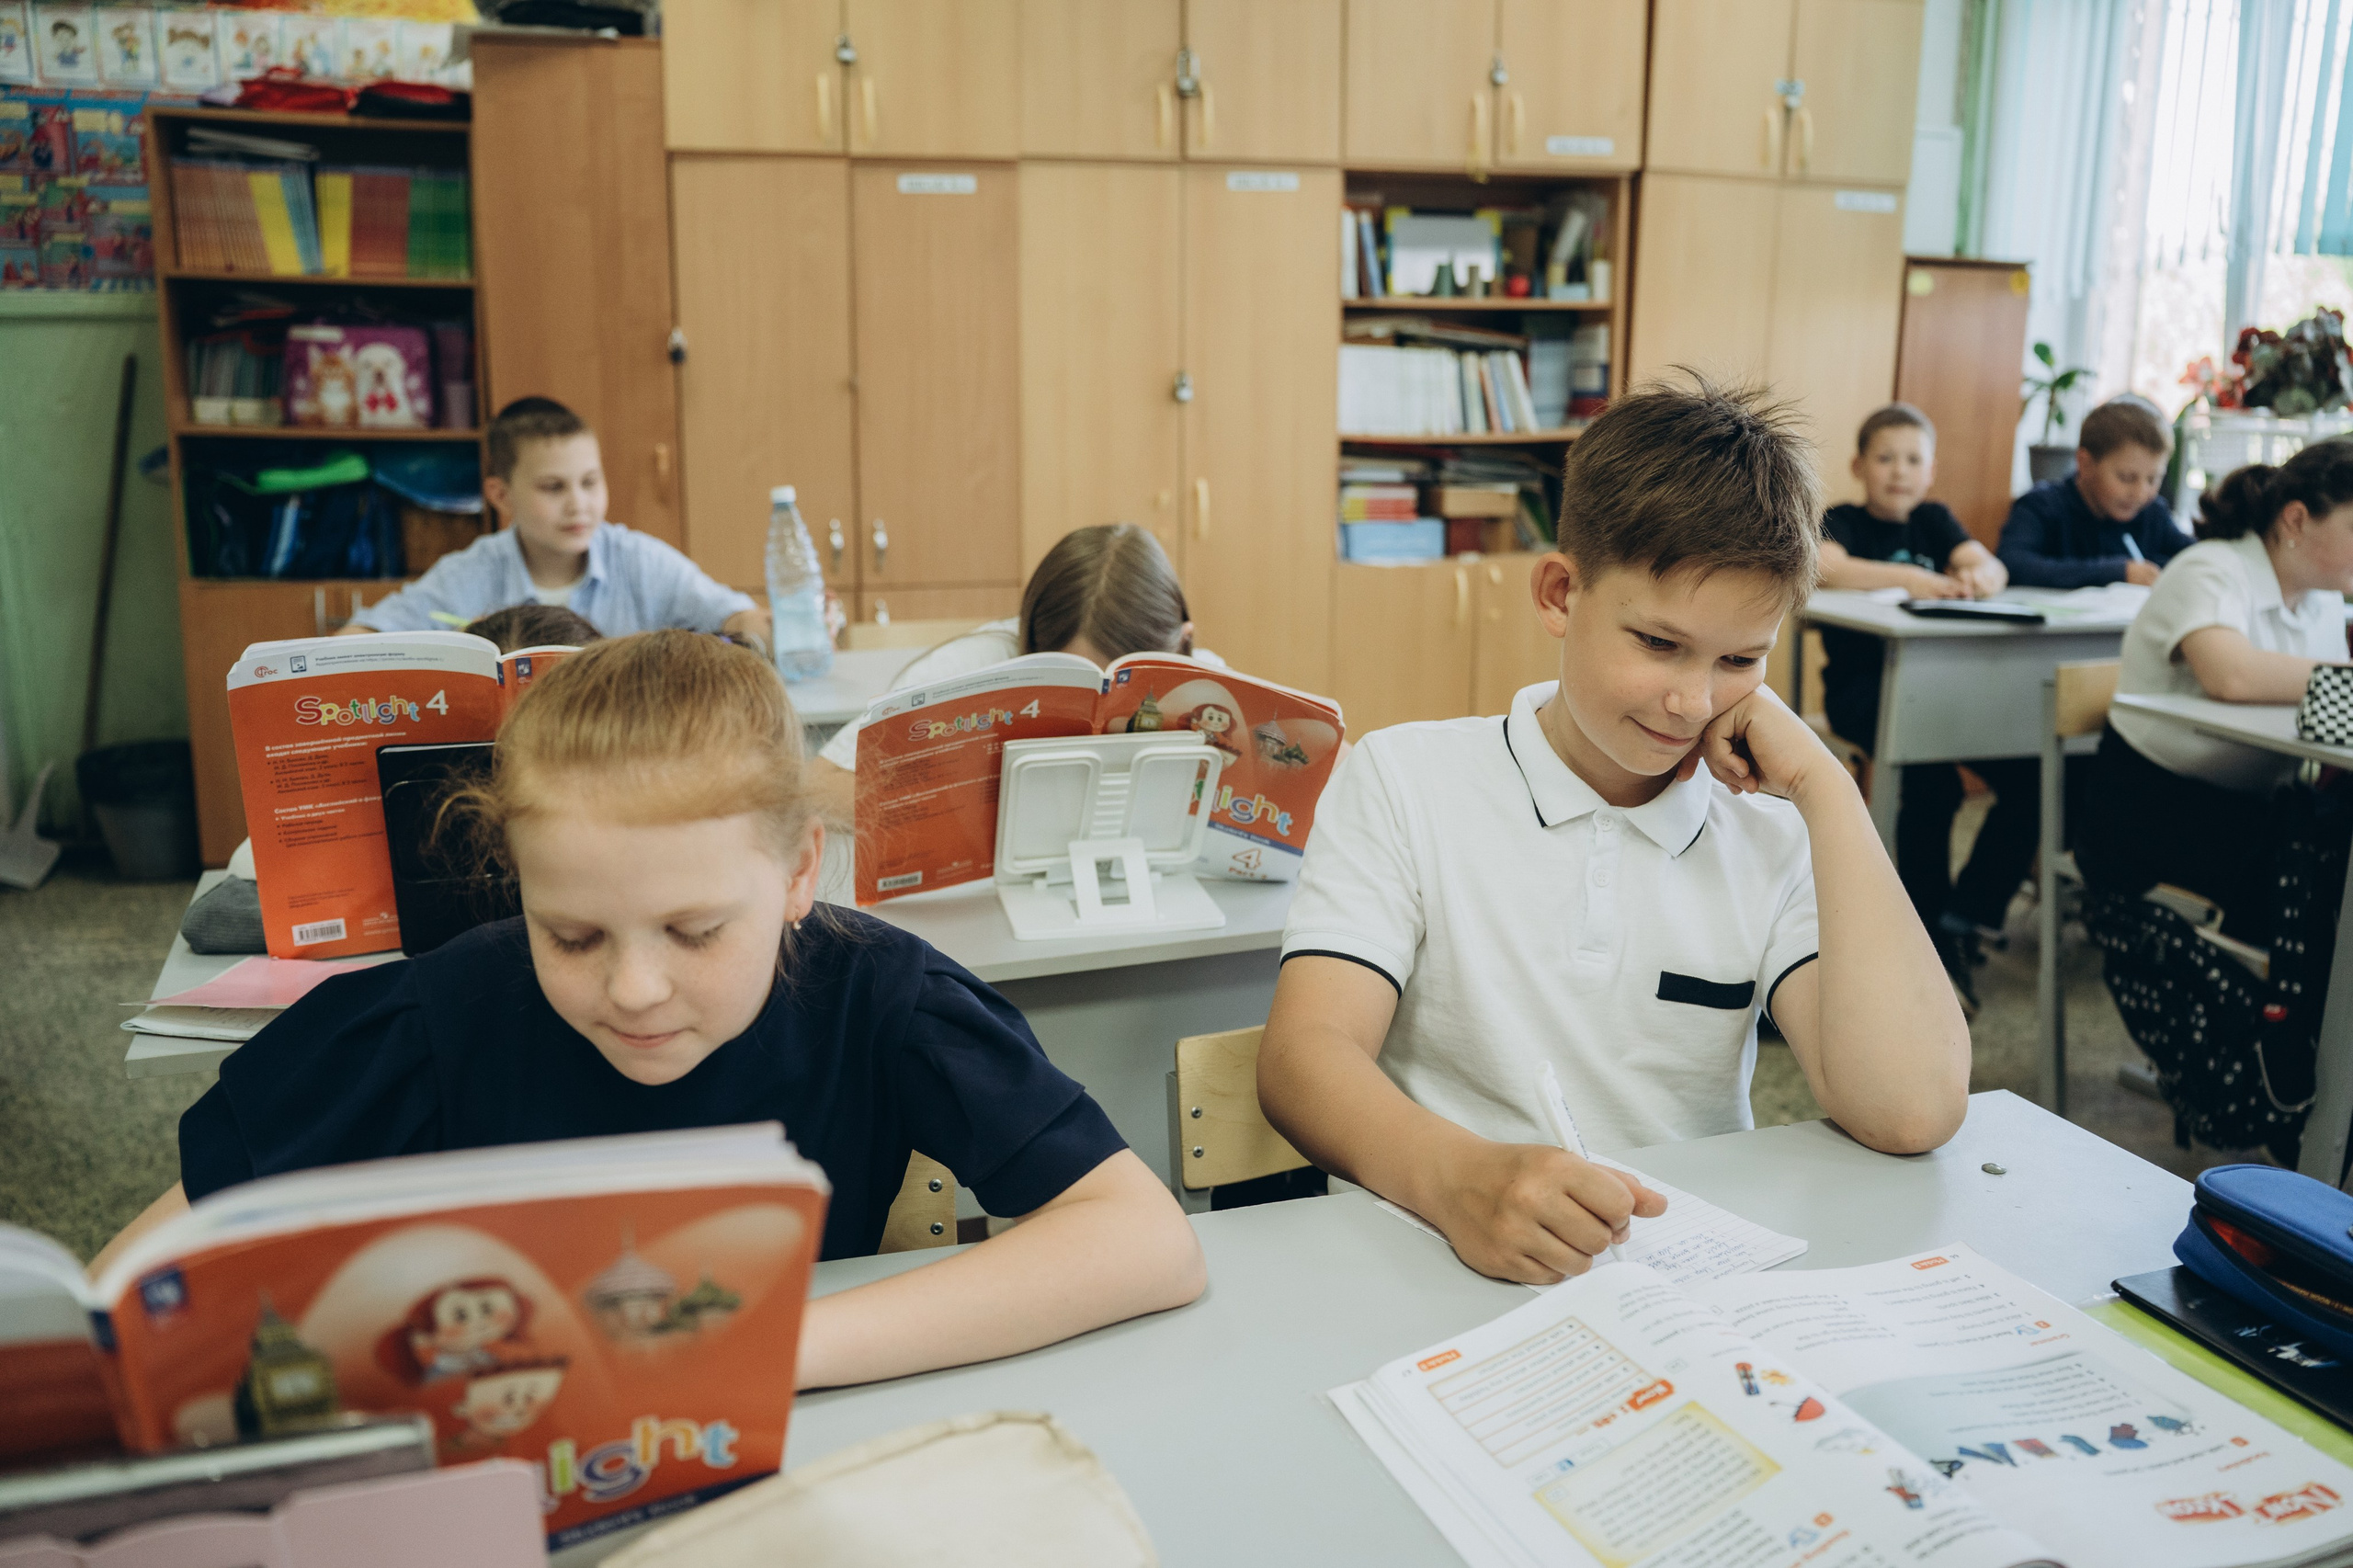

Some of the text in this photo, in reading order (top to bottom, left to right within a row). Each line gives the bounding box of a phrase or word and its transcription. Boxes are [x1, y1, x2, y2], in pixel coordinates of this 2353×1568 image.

[294, 689, 449, 725] Spotlight 4
[908, 699, 1040, 741] Spotlight 4
[1232, 847, 1261, 870] 4
[539, 1415, 739, 1512] ight
